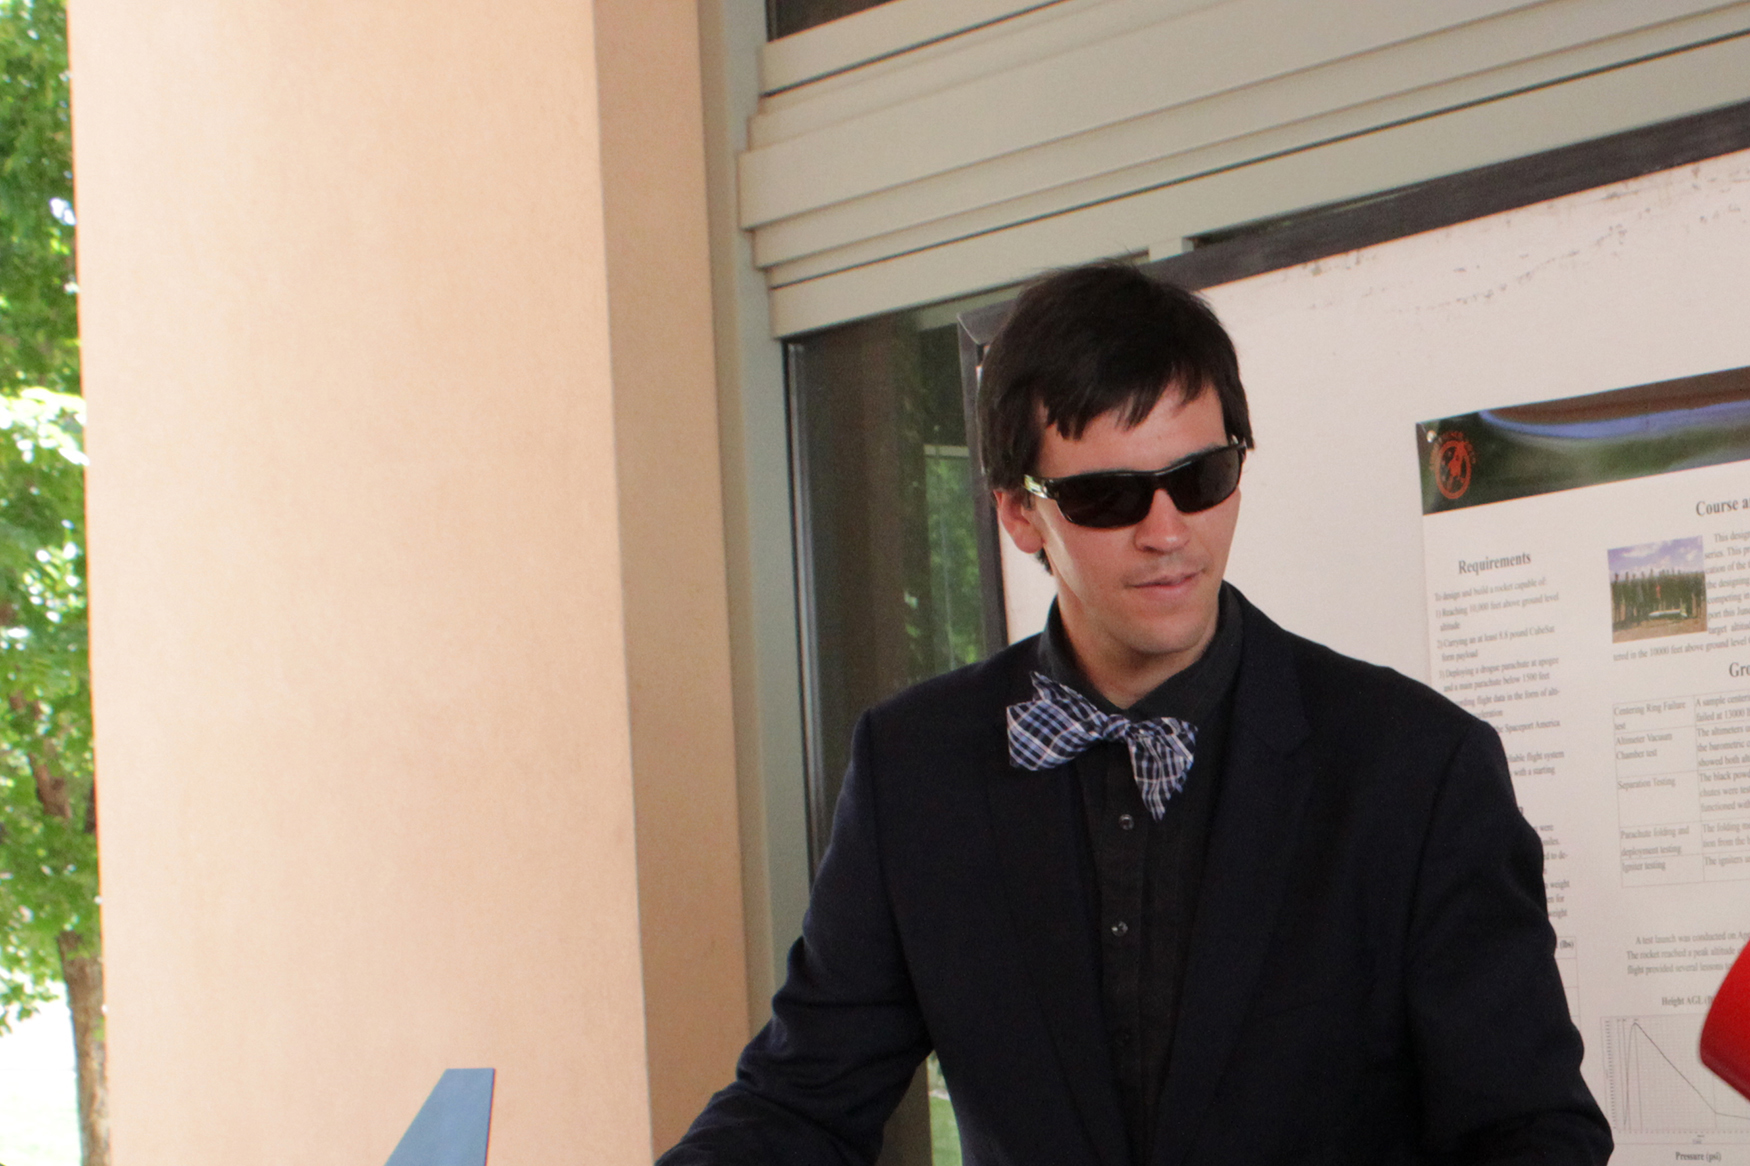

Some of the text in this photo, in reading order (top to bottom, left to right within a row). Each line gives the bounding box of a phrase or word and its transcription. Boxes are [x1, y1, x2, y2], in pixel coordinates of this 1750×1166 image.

[1696, 500, 1738, 517] Course
[1713, 533, 1728, 543] This
[1729, 530, 1750, 541] design
[1458, 552, 1532, 575] Requirements
[1675, 1152, 1704, 1161] Pressure
